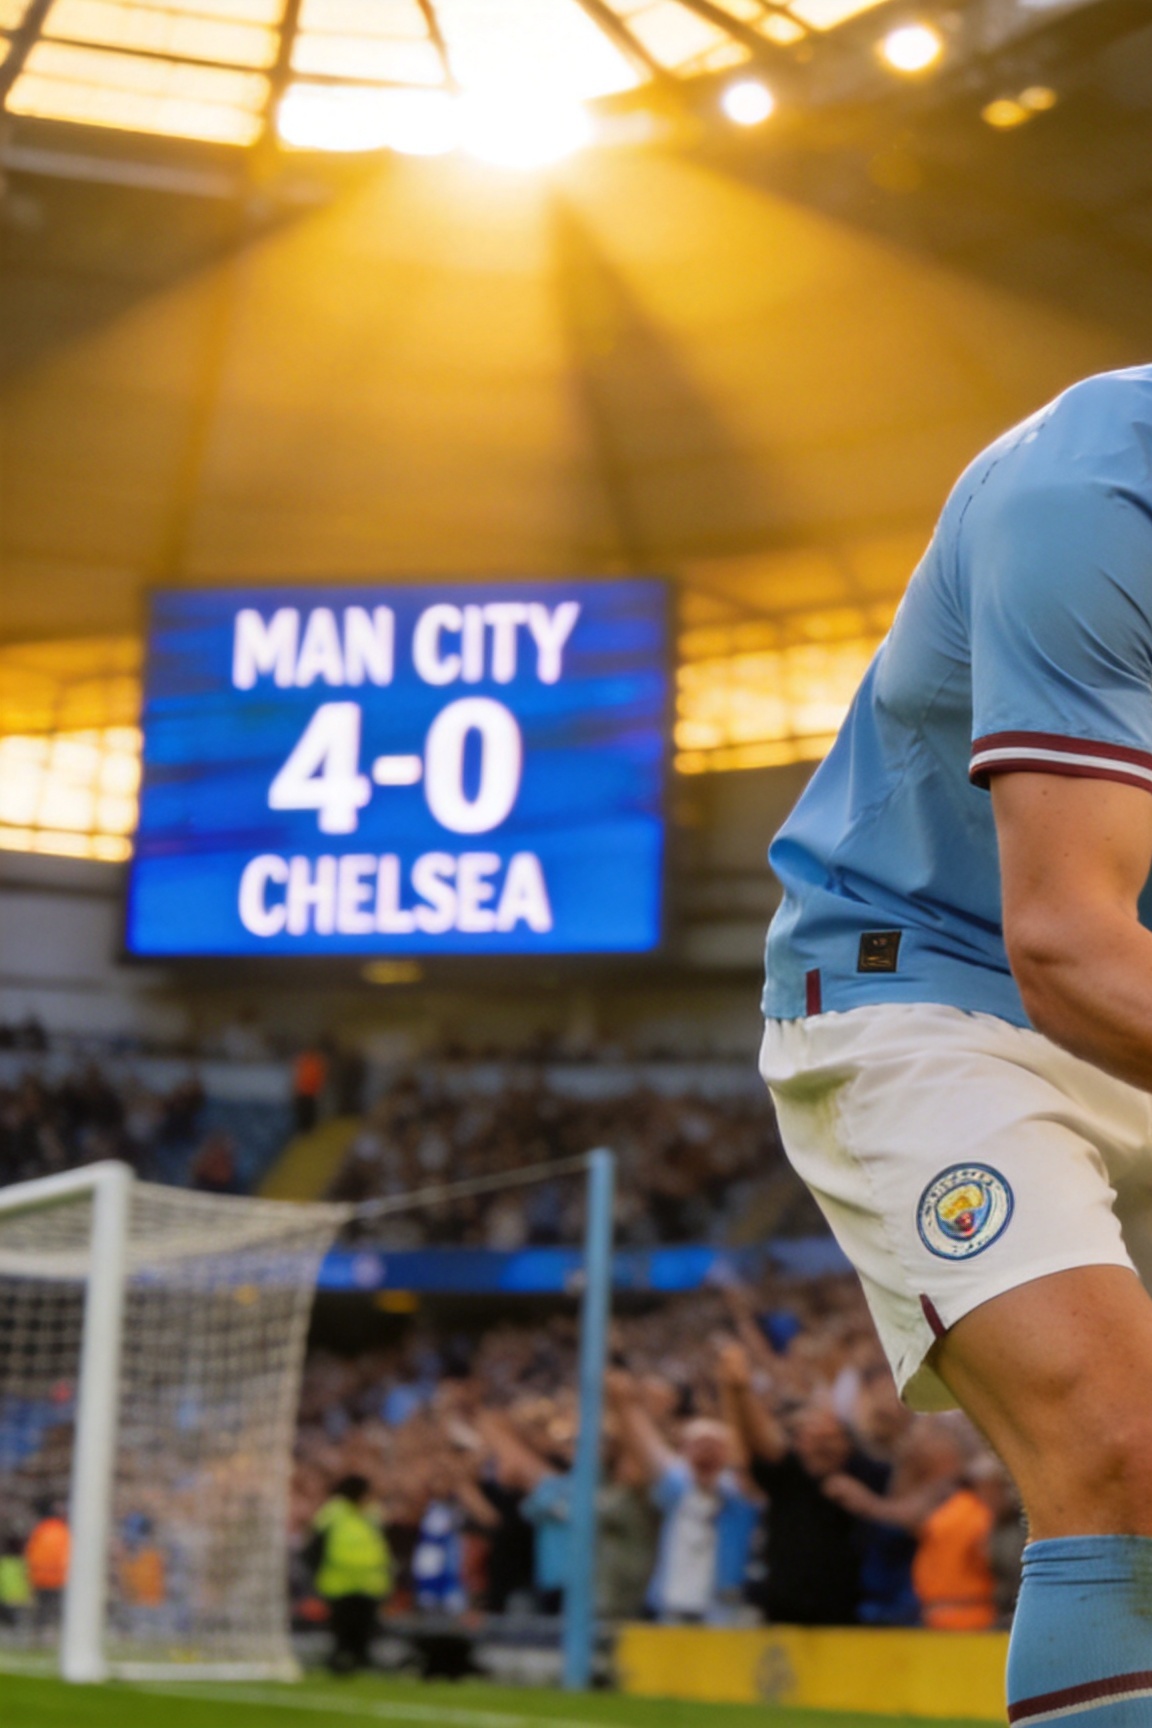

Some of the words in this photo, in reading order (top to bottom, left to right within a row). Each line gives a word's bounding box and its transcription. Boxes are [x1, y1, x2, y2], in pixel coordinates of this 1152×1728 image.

[233, 606, 395, 690] MAN
[412, 601, 580, 686] CITY
[268, 697, 521, 834] 4-0
[238, 851, 553, 937] CHELSEA
